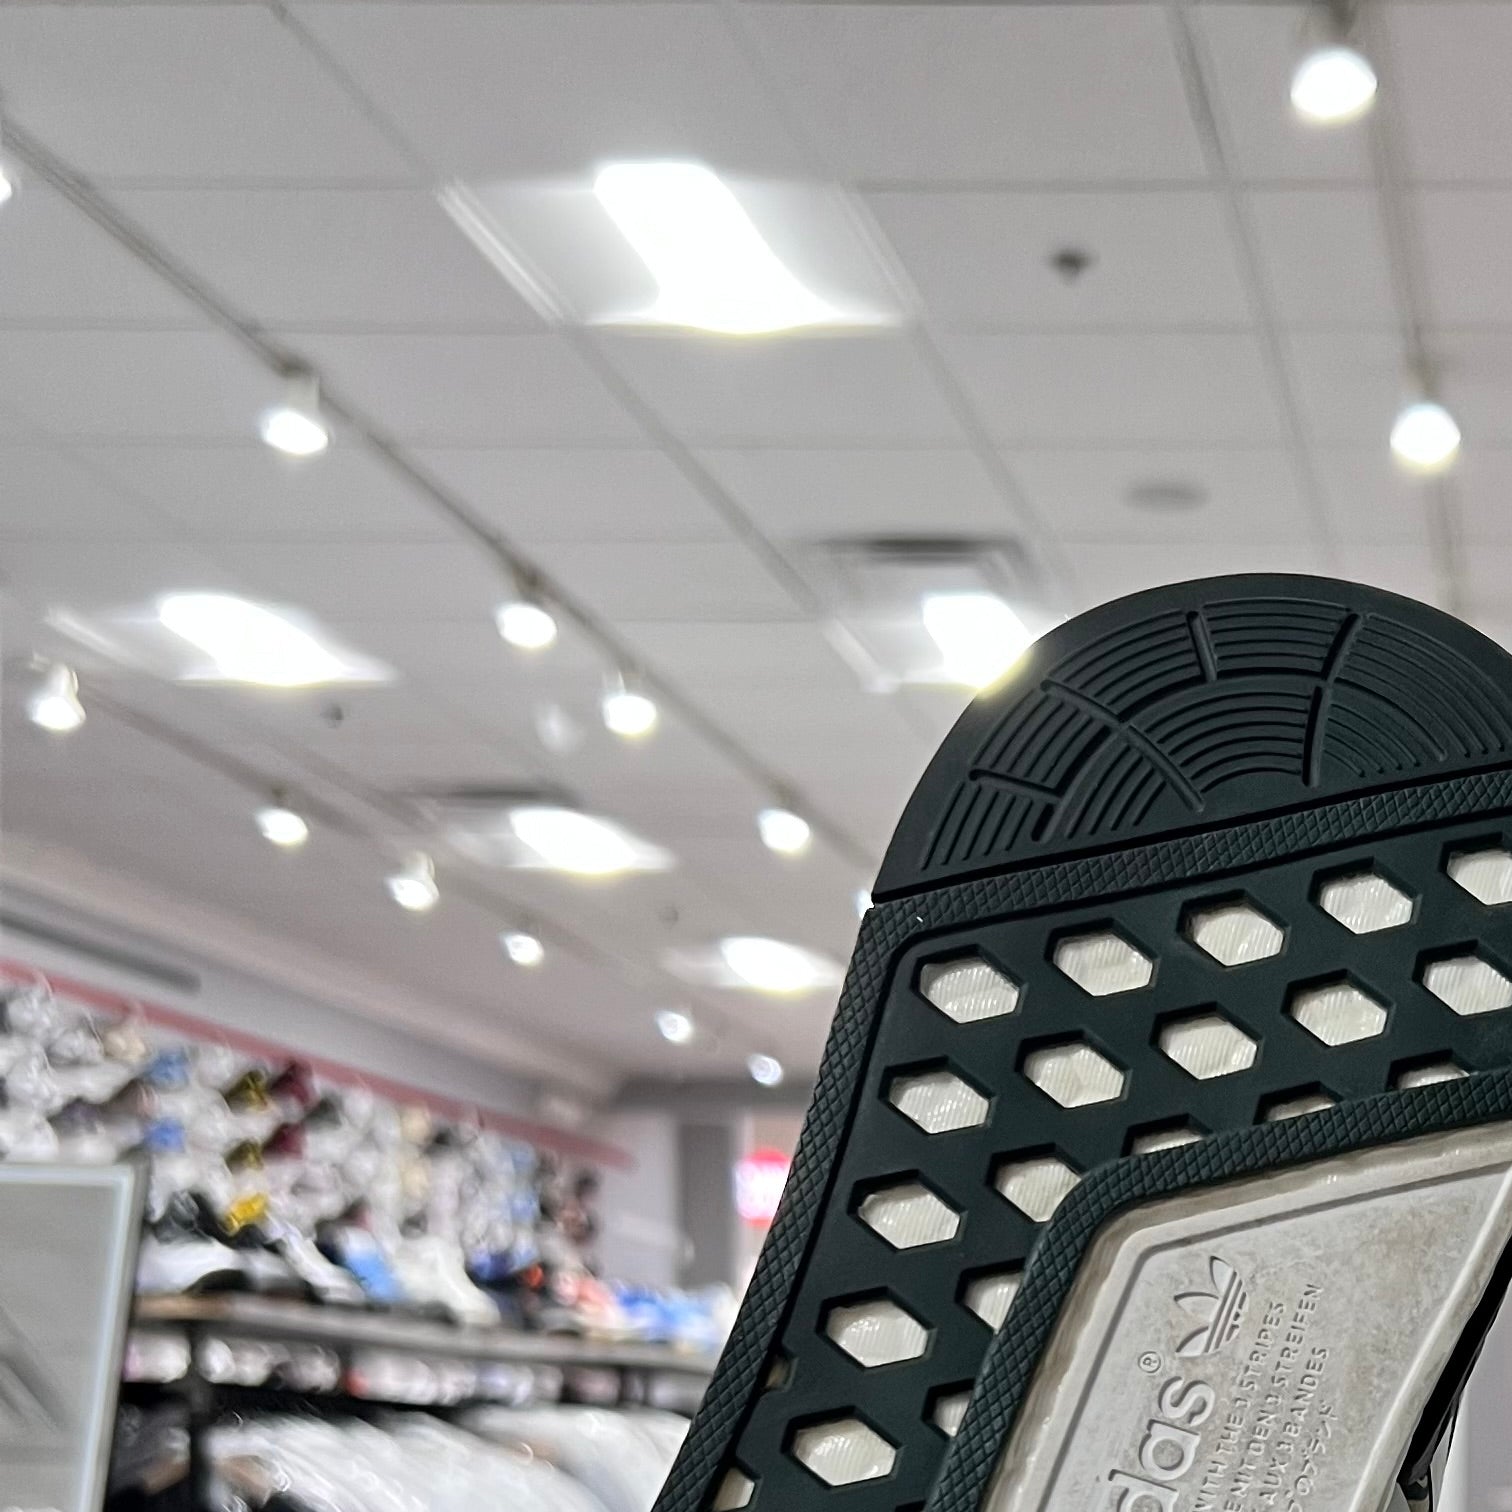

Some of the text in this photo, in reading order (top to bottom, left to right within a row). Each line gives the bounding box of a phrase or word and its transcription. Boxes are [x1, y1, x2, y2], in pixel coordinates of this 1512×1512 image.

[1215, 1413, 1245, 1455] THE
[1239, 1301, 1286, 1392] STRIPES
[1230, 1458, 1257, 1498] MIT
[1248, 1409, 1278, 1456] DEN
[1271, 1283, 1324, 1388] STREIFEN
[1258, 1457, 1288, 1506] AUX
[1283, 1346, 1330, 1438] BANDES
